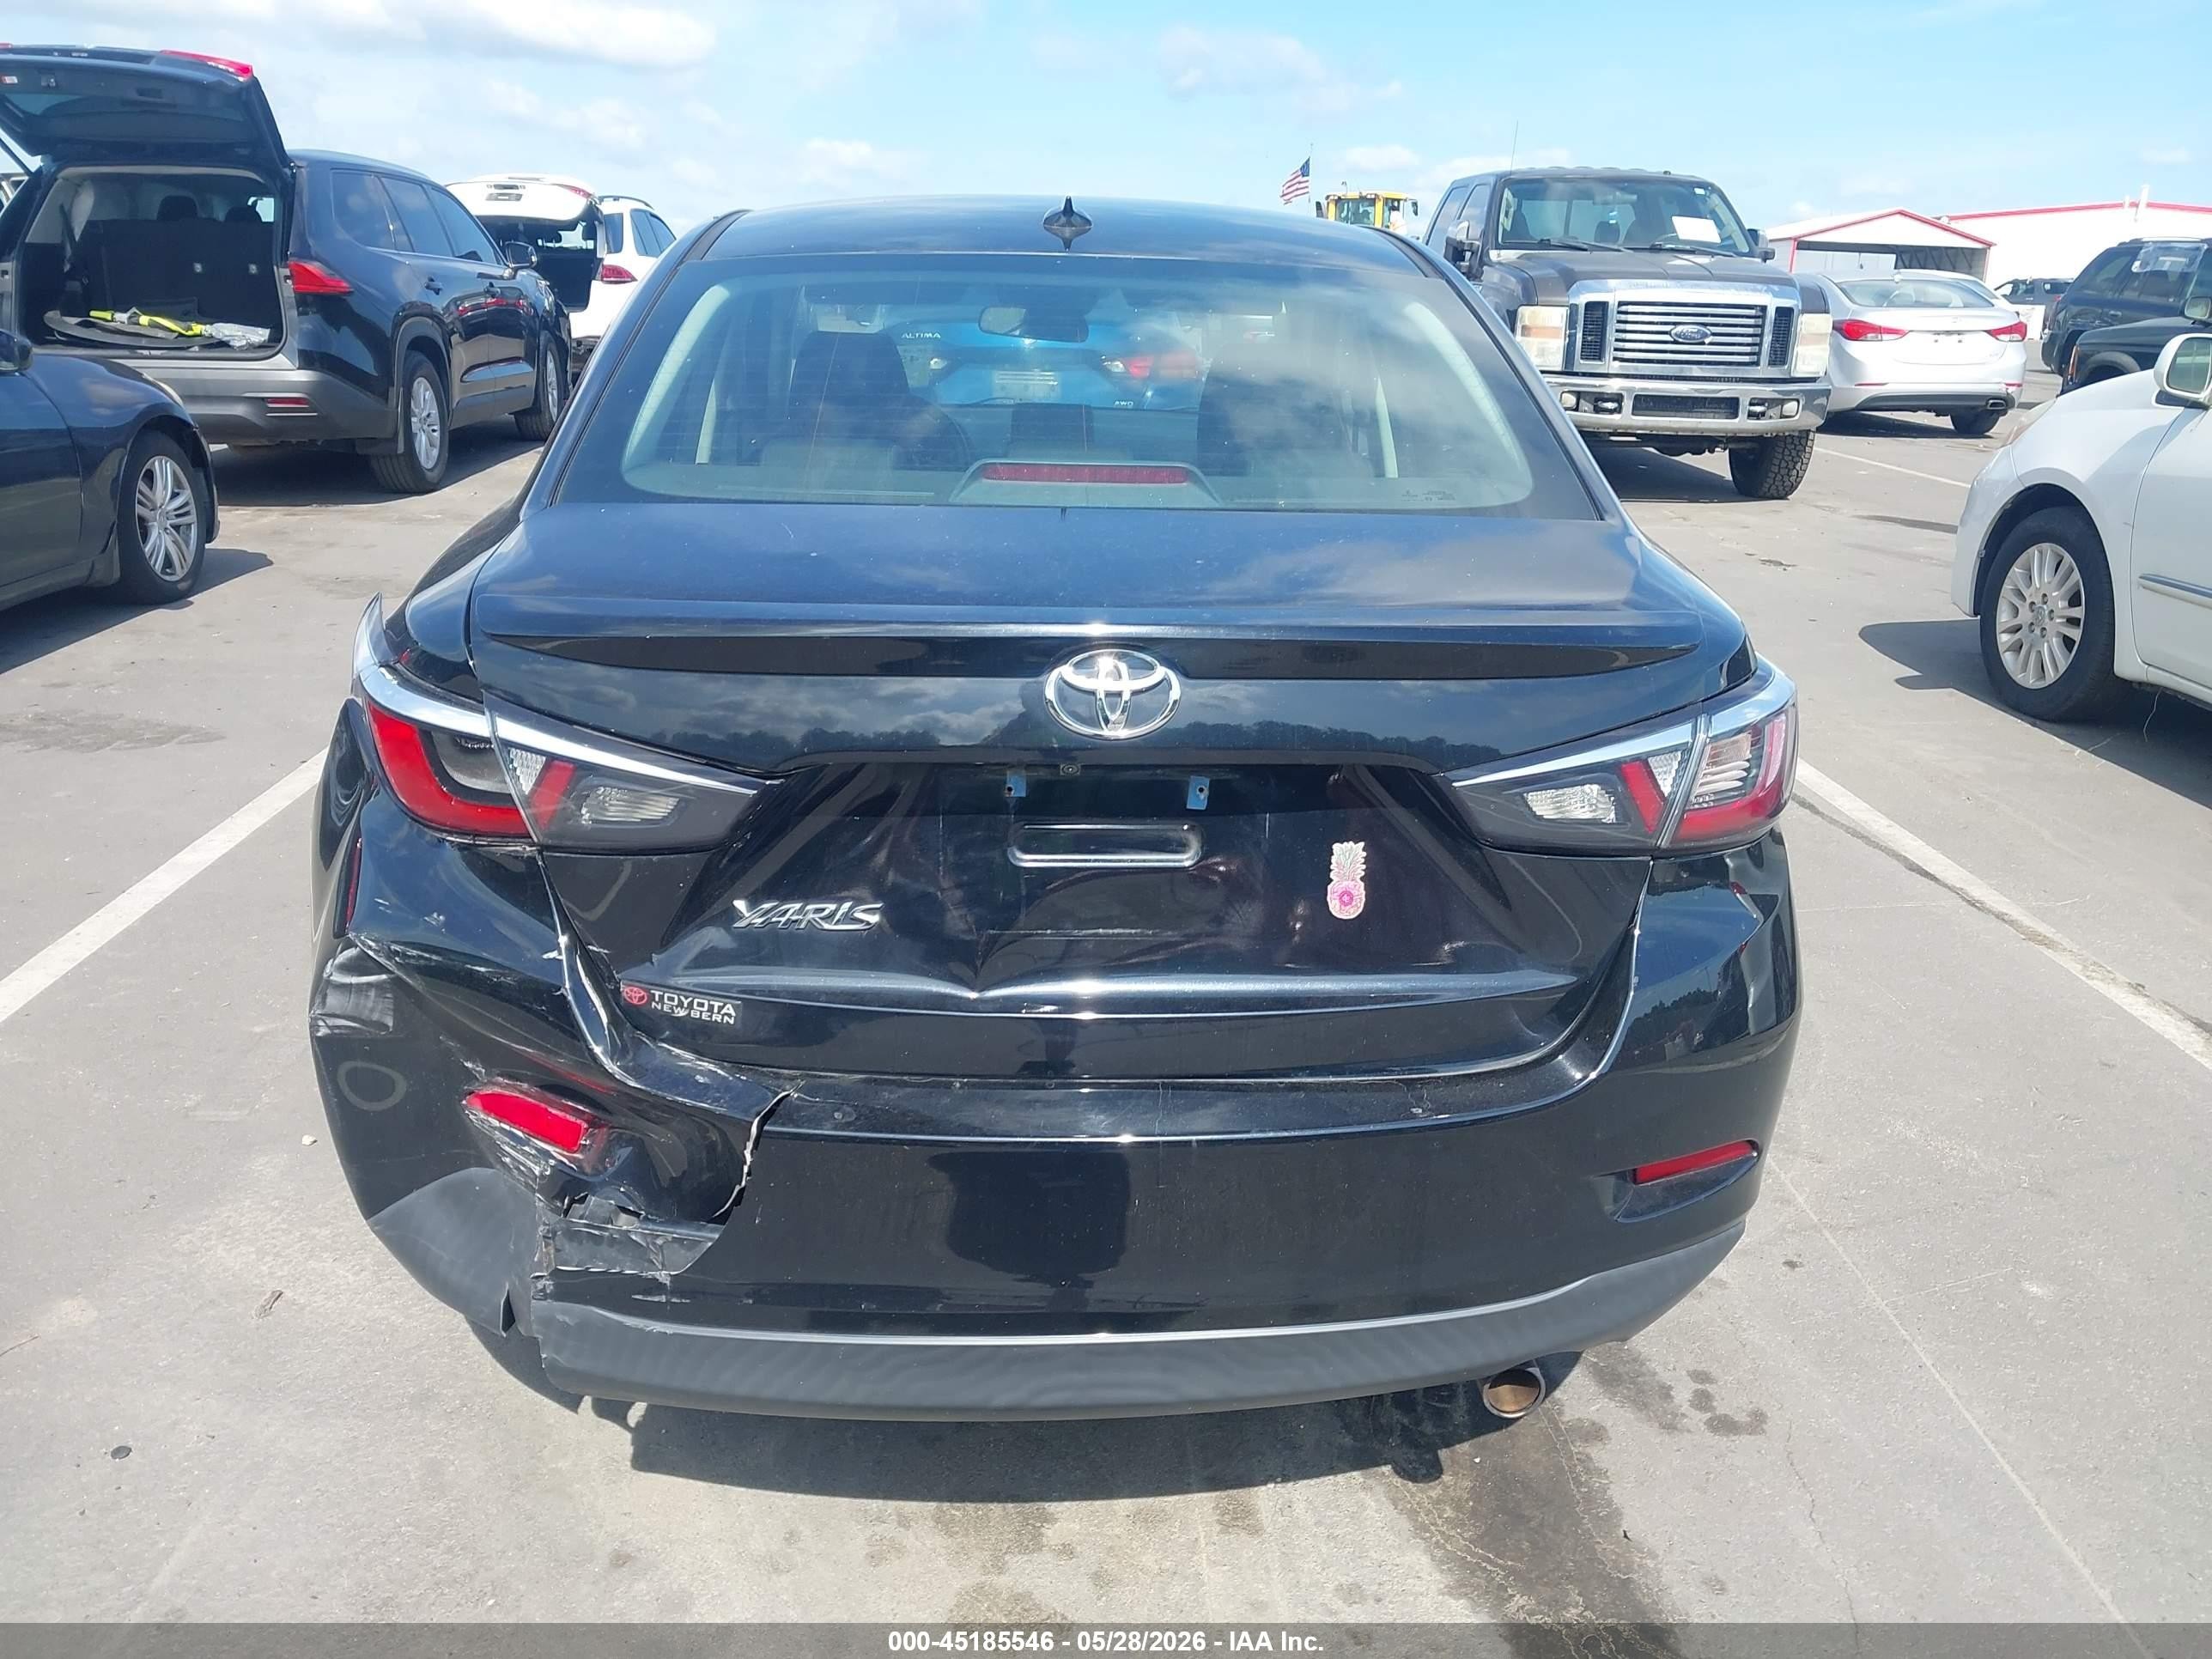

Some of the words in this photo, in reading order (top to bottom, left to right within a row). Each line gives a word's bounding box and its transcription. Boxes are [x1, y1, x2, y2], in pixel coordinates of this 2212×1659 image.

[732, 900, 884, 930] YARIS
[650, 990, 737, 1017] TOYOTA
[651, 1001, 685, 1015] NEW
[690, 1009, 735, 1024] BERN
